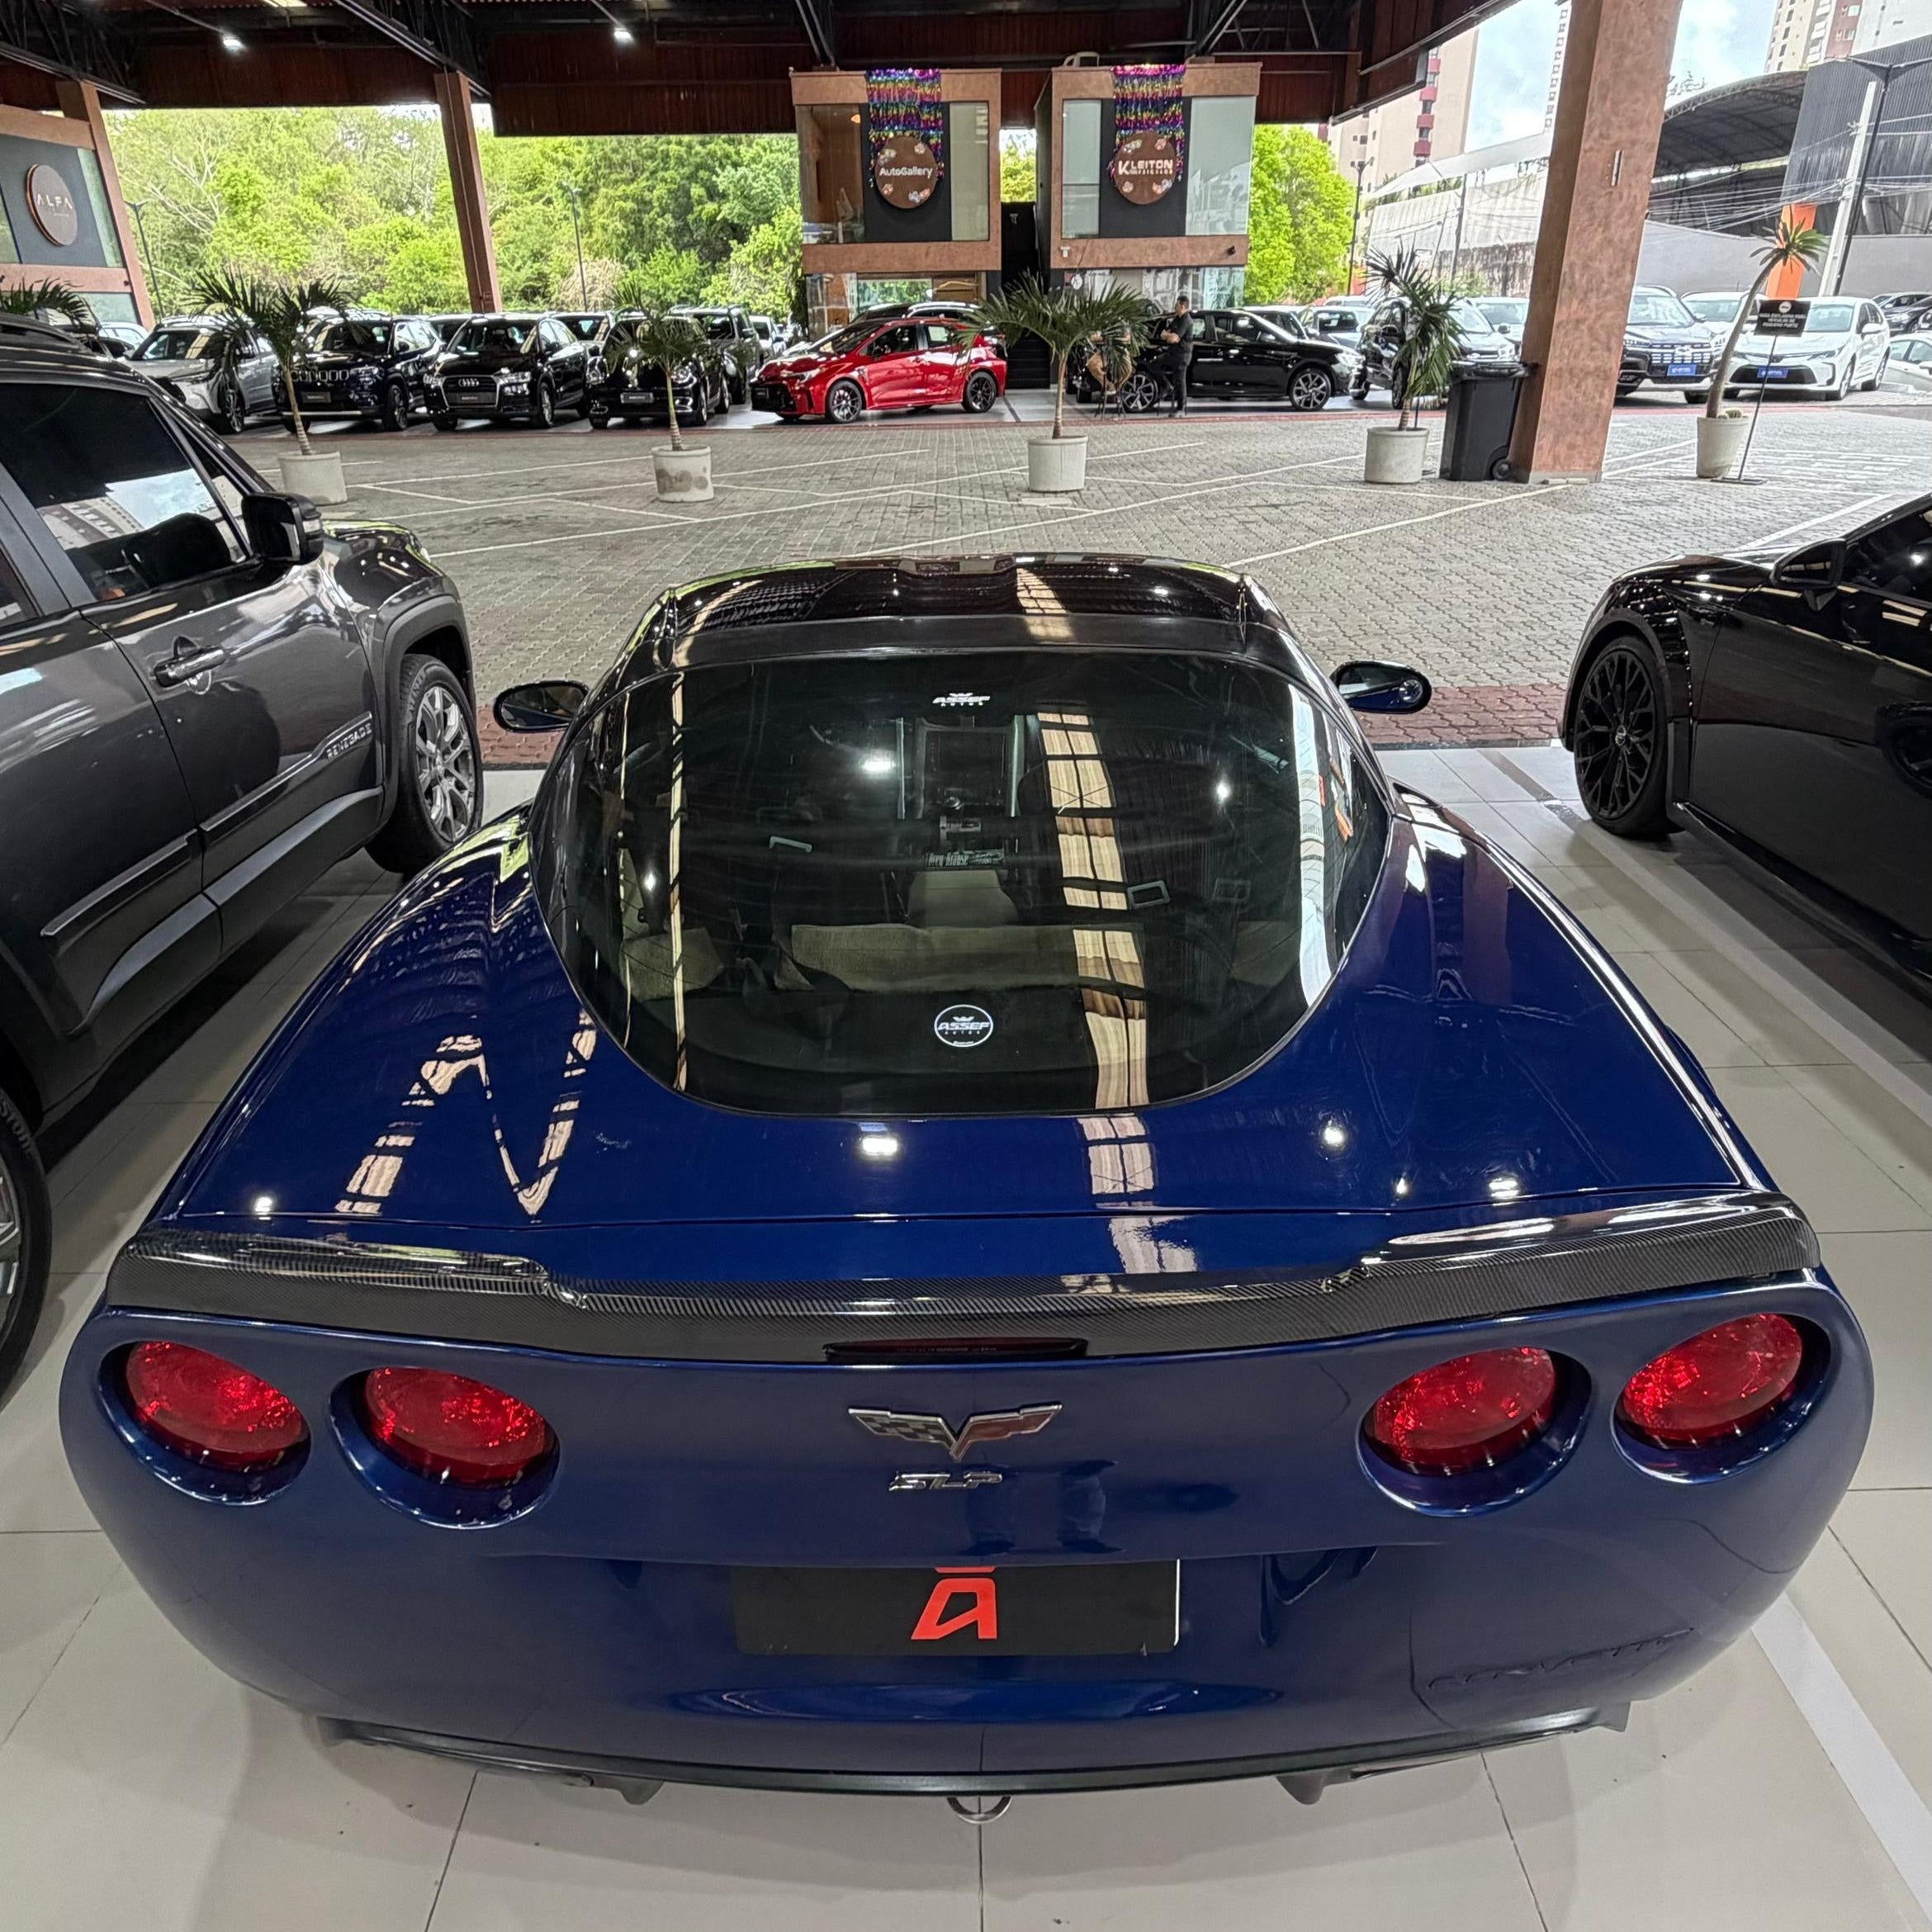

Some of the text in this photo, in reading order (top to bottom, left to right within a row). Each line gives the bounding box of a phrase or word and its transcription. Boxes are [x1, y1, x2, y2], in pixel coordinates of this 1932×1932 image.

[879, 166, 933, 179] AutoGallery
[1118, 159, 1173, 175] KLEITON
[37, 193, 73, 210] ALFA
[326, 722, 372, 760] RENEGADE
[937, 1022, 990, 1031] ASSEF
[888, 1472, 1003, 1491] SLP
